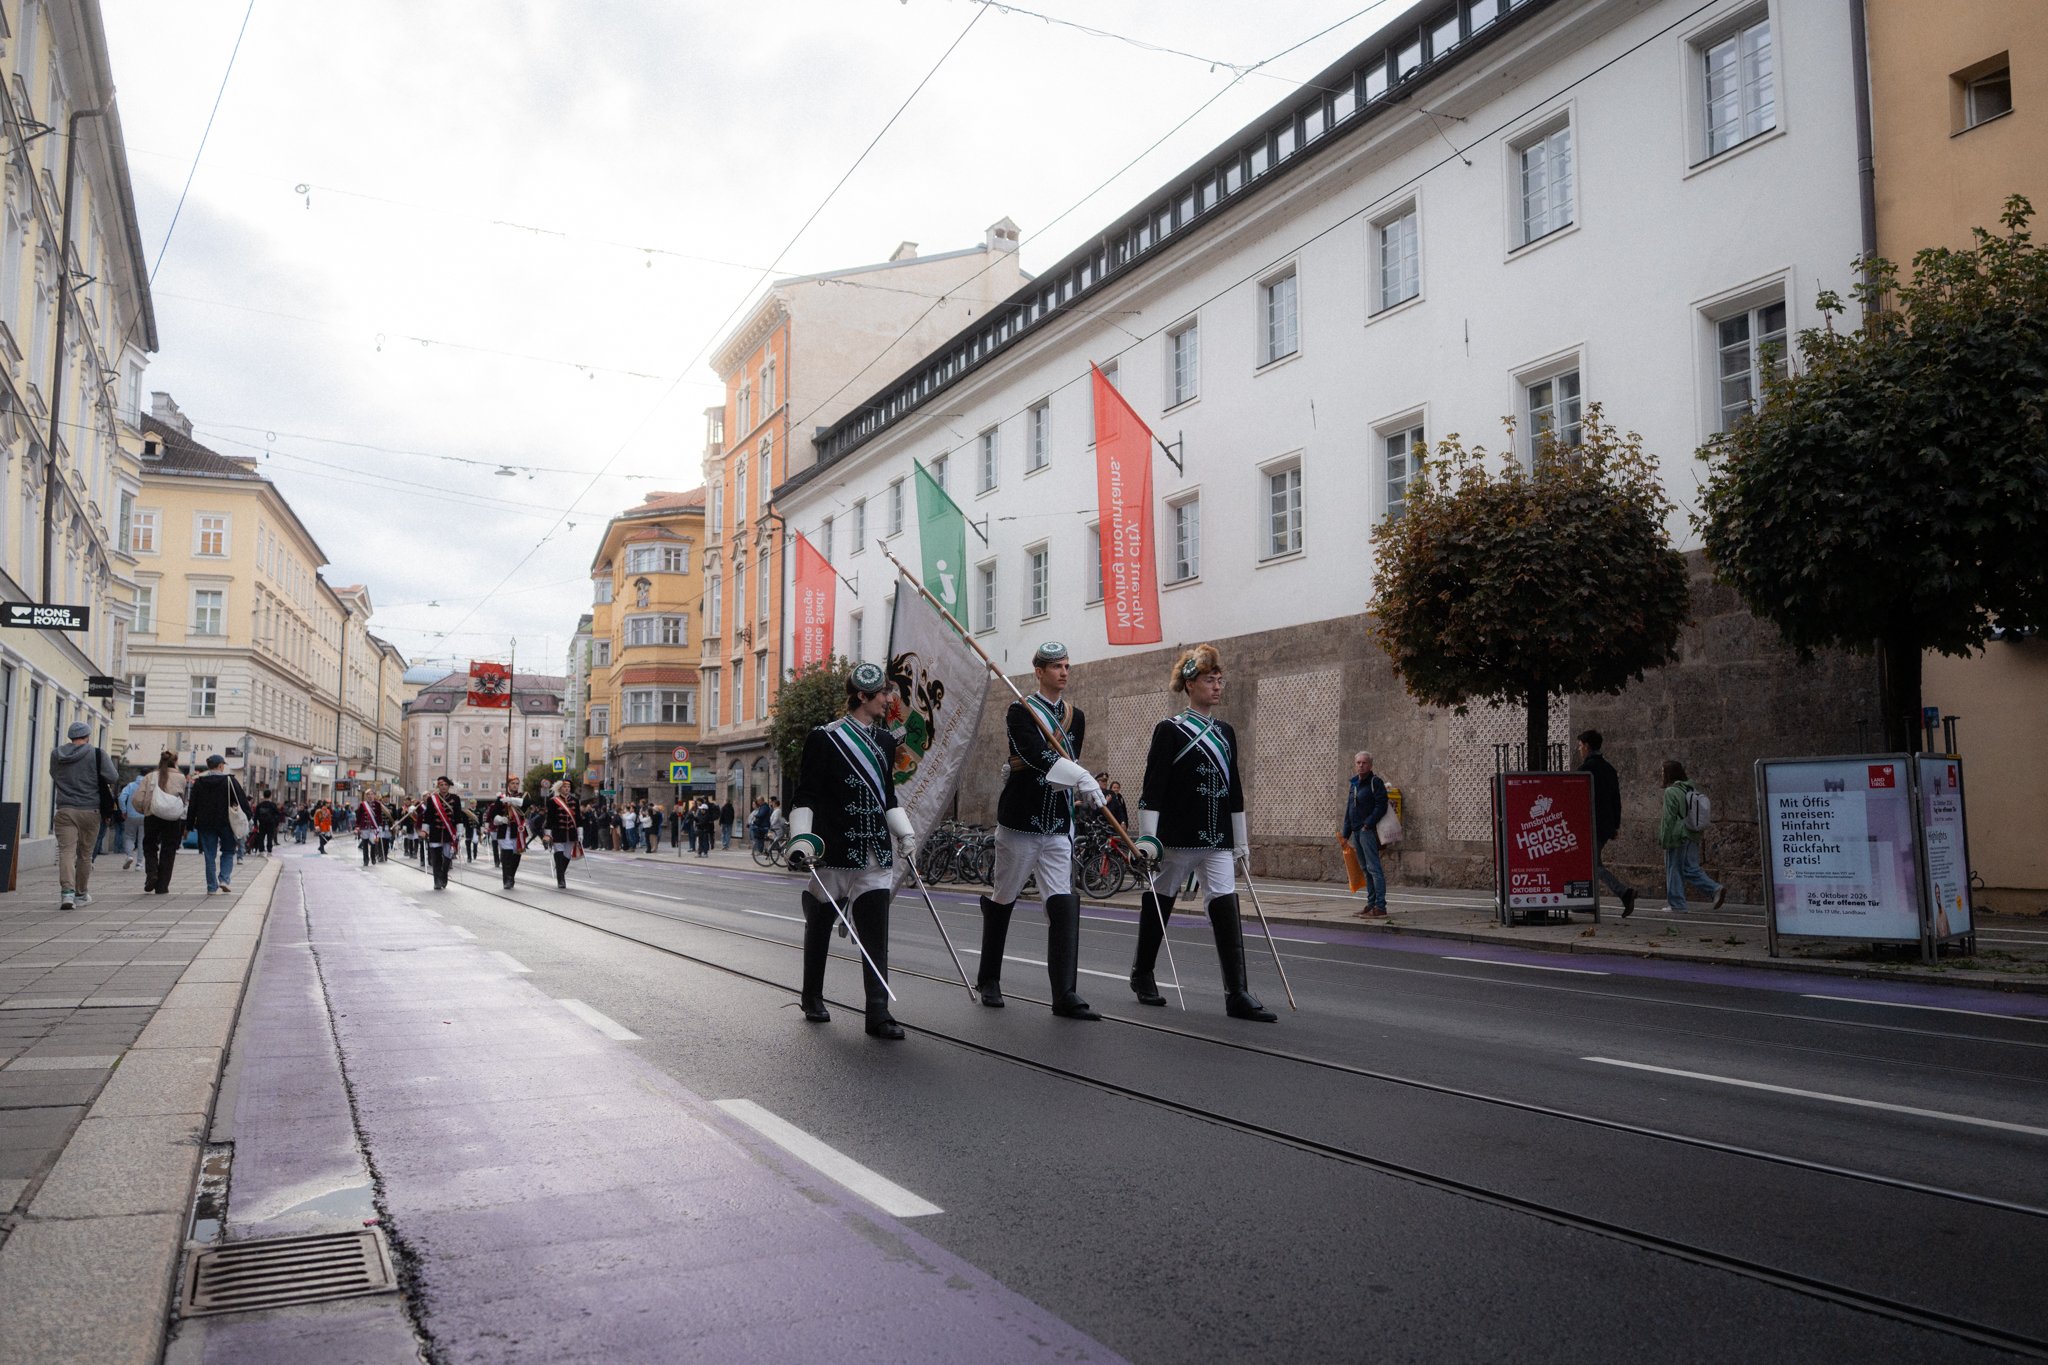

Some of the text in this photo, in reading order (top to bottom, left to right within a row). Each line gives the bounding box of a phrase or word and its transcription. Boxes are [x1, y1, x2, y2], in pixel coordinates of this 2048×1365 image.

[34, 607, 71, 618] MONS
[33, 616, 81, 627] ROYALE
[677, 750, 685, 759] 30
[1780, 795, 1830, 808] Mit Öffis
[1780, 808, 1835, 819] anreisen:
[1520, 811, 1563, 831] Innsbrucker
[1781, 820, 1830, 830] Hinfahrt
[1516, 819, 1570, 850] Herbst
[1782, 831, 1824, 843] zahlen,
[1527, 833, 1578, 860] messe
[1783, 842, 1841, 853] Rückfahrt
[1783, 854, 1821, 868] gratis!
[1820, 891, 1849, 899] Oktober
[1807, 898, 1821, 907] Tag
[1837, 899, 1866, 907] offenen
